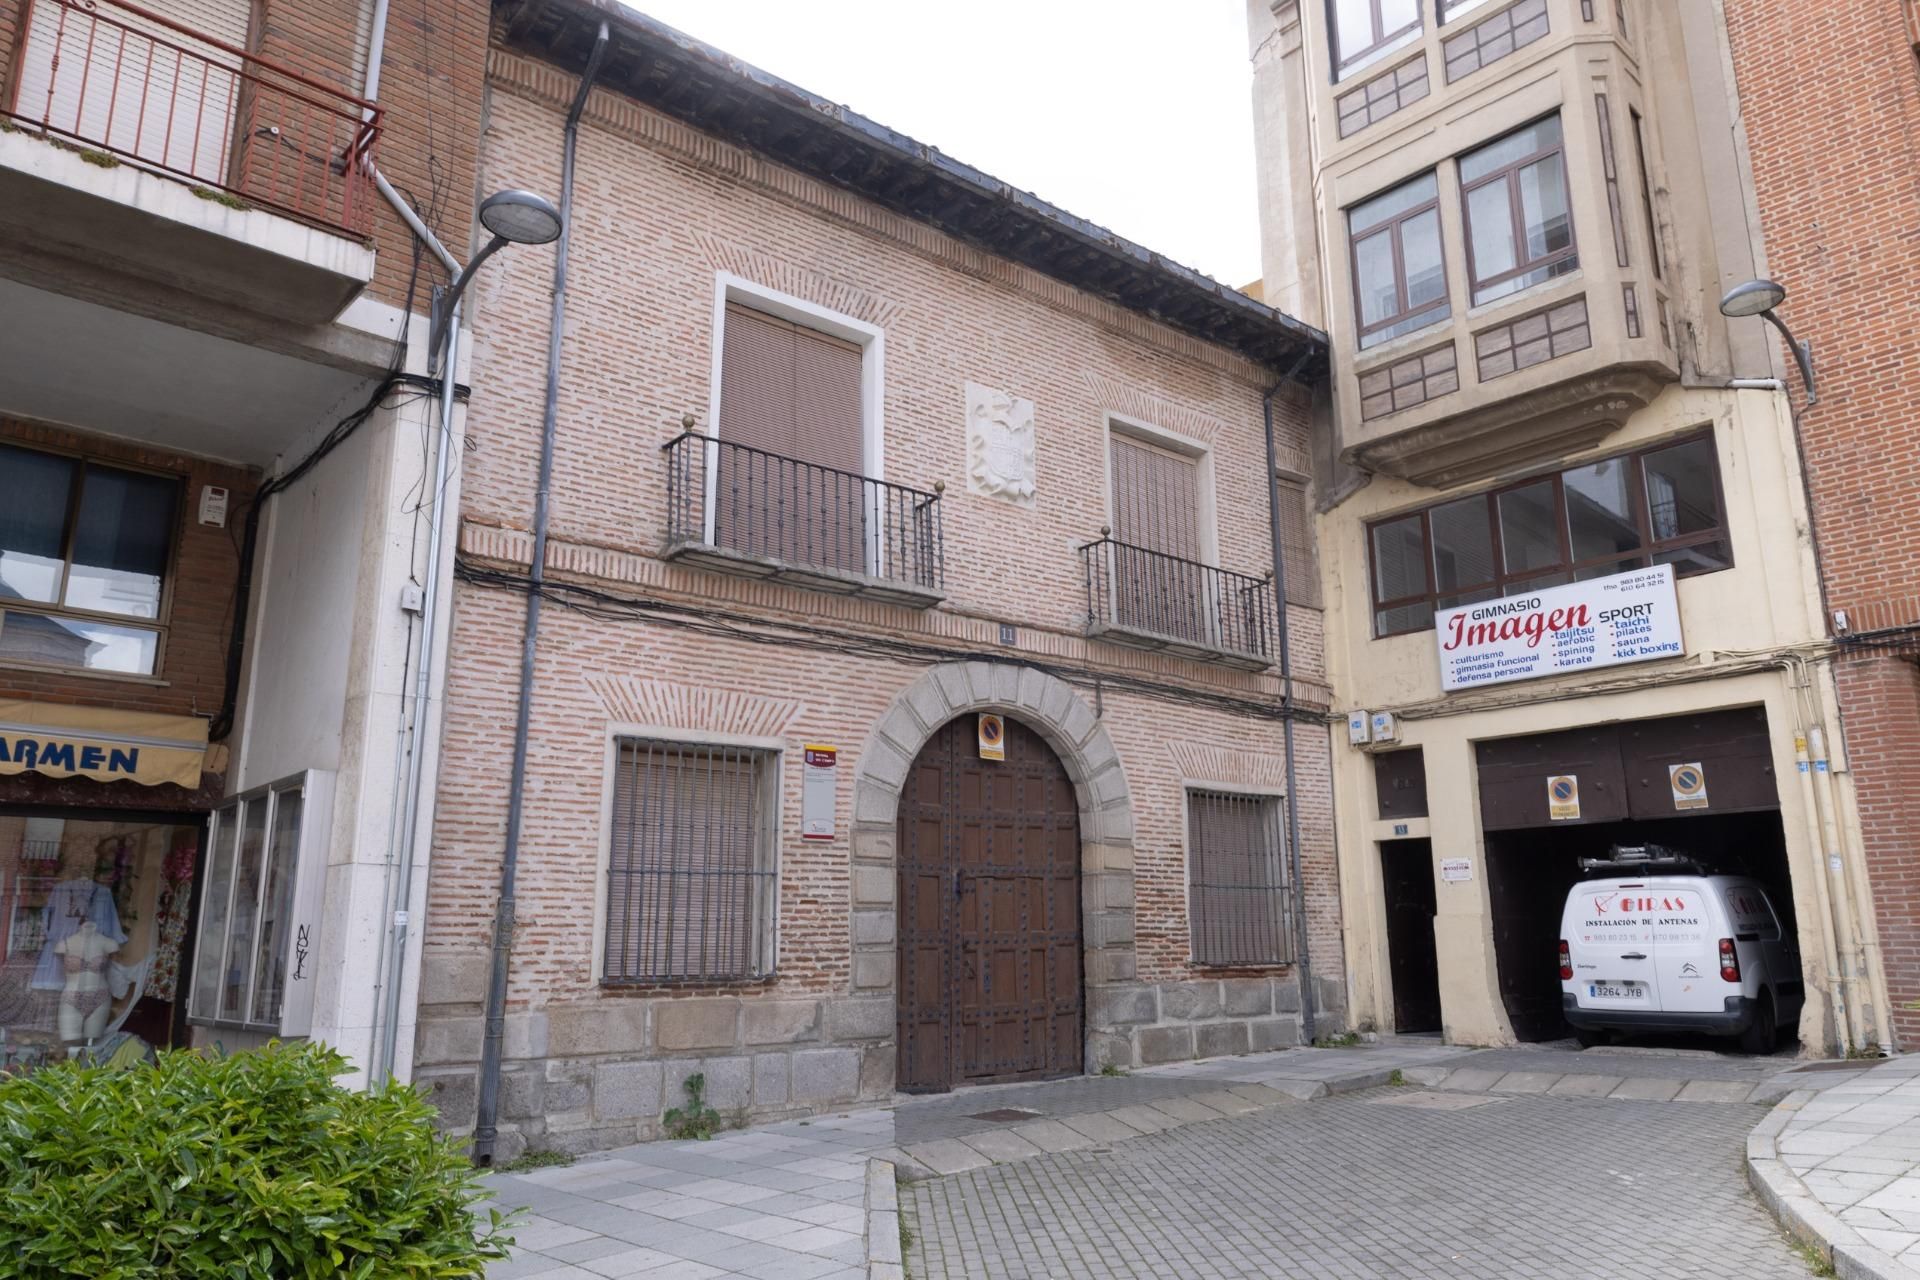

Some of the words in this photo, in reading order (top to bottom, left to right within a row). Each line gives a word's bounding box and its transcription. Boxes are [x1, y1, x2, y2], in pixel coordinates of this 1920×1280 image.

[1472, 598, 1541, 620] GIMNASIO
[1443, 603, 1591, 648] Imagen
[1599, 602, 1654, 624] SPORT
[1614, 616, 1650, 629] taichi
[1001, 627, 1013, 641] 11
[1554, 625, 1595, 640] taijitsu
[1615, 624, 1652, 638] pilates
[1557, 634, 1595, 648] aerobic
[1617, 636, 1650, 648] sauna
[1558, 645, 1595, 660] spining
[1618, 647, 1638, 659] kick
[1640, 641, 1680, 656] boxing
[1455, 650, 1504, 665] culturismo
[1559, 655, 1593, 667] karate
[1456, 661, 1495, 676] gimnasia
[1497, 654, 1540, 668] funcional
[1457, 671, 1492, 684] defensa
[1494, 665, 1533, 680] personal
[1585, 918, 1637, 927] INSTALACIÓN
[1642, 918, 1652, 926] DE
[1658, 918, 1698, 926] ANTENAS
[1597, 986, 1620, 997] 3264
[1623, 987, 1642, 997] JYB
